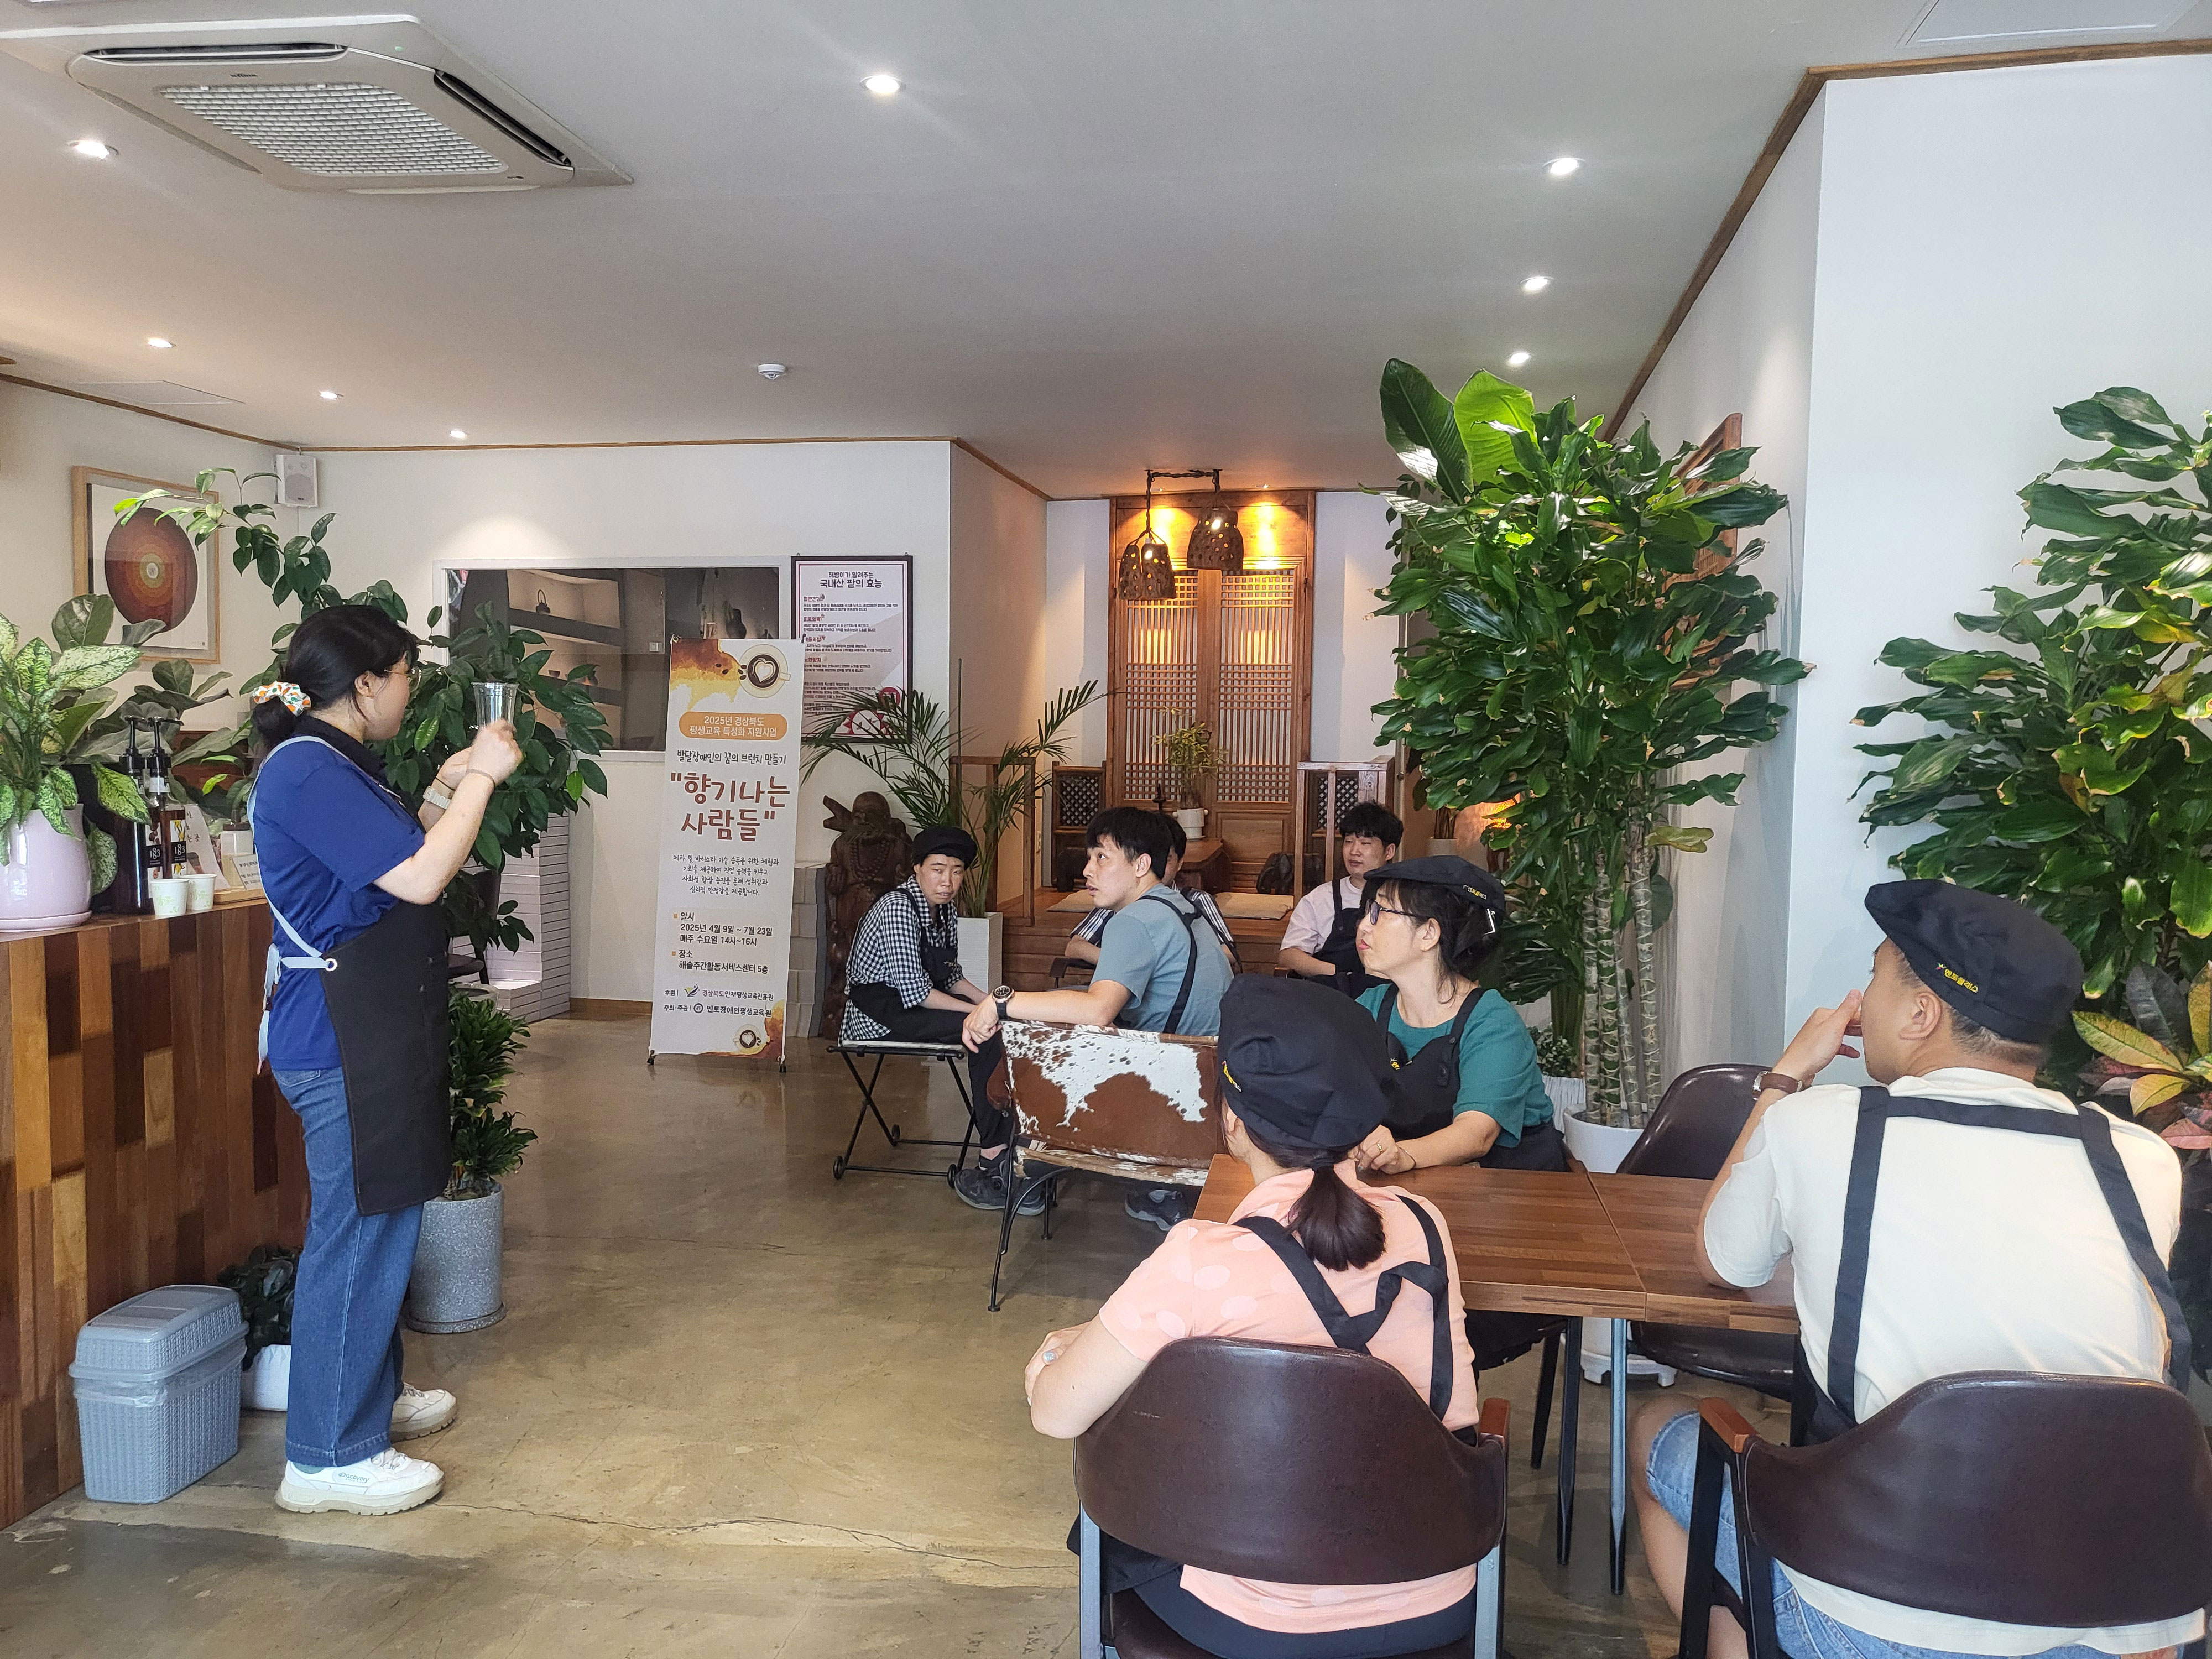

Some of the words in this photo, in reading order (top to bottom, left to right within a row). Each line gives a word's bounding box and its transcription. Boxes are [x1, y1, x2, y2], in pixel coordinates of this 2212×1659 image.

[820, 579, 844, 588] 국내산
[847, 579, 863, 588] 팥의
[866, 578, 882, 588] 효능
[705, 716, 732, 725] 2025년
[734, 716, 764, 726] 경상북도
[690, 725, 721, 735] 평생교육
[723, 726, 745, 736] 특성화
[748, 727, 776, 737] 지원사업
[677, 749, 722, 763] 발달장애인의
[724, 752, 738, 764] 꿈의
[742, 753, 763, 764] 브런치
[765, 753, 786, 765] 만들기
[671, 772, 790, 807] "향기나는
[681, 809, 775, 841] 사람들"
[687, 854, 693, 863] 및
[719, 857, 728, 865] 기술
[731, 857, 745, 865] 습득을
[761, 858, 779, 867] 체험과
[683, 864, 698, 874] 기회를
[700, 865, 722, 874] 제공하여
[724, 867, 734, 875] 직업
[737, 867, 752, 876] 능력을
[682, 875, 699, 884] 사회성
[701, 875, 713, 884] 향상
[716, 876, 731, 885] 증진을
[733, 877, 743, 886] 통해
[745, 878, 768, 886] 성취감과
[690, 885, 706, 894] 심리적
[708, 886, 729, 895] 안정감을
[732, 888, 760, 896] 제공합니다.
[680, 912, 695, 921] 일시
[680, 924, 706, 932] 2025년
[709, 925, 721, 933] 4월
[723, 925, 734, 934] 9일
[744, 926, 755, 935] 7월
[757, 927, 773, 936] 23일
[680, 935, 694, 943] 매주
[696, 935, 718, 945] 수요일
[721, 936, 757, 946] 14시~16시
[678, 950, 693, 958] 장소
[679, 961, 755, 973] 해솔주간활동서비스센터
[757, 965, 768, 974] 5층
[702, 989, 774, 1001] 경상북도인재평생교육진흥원
[707, 1005, 771, 1018] 멘토장애인평생교육원
[341, 1472, 370, 1483] Discovery
